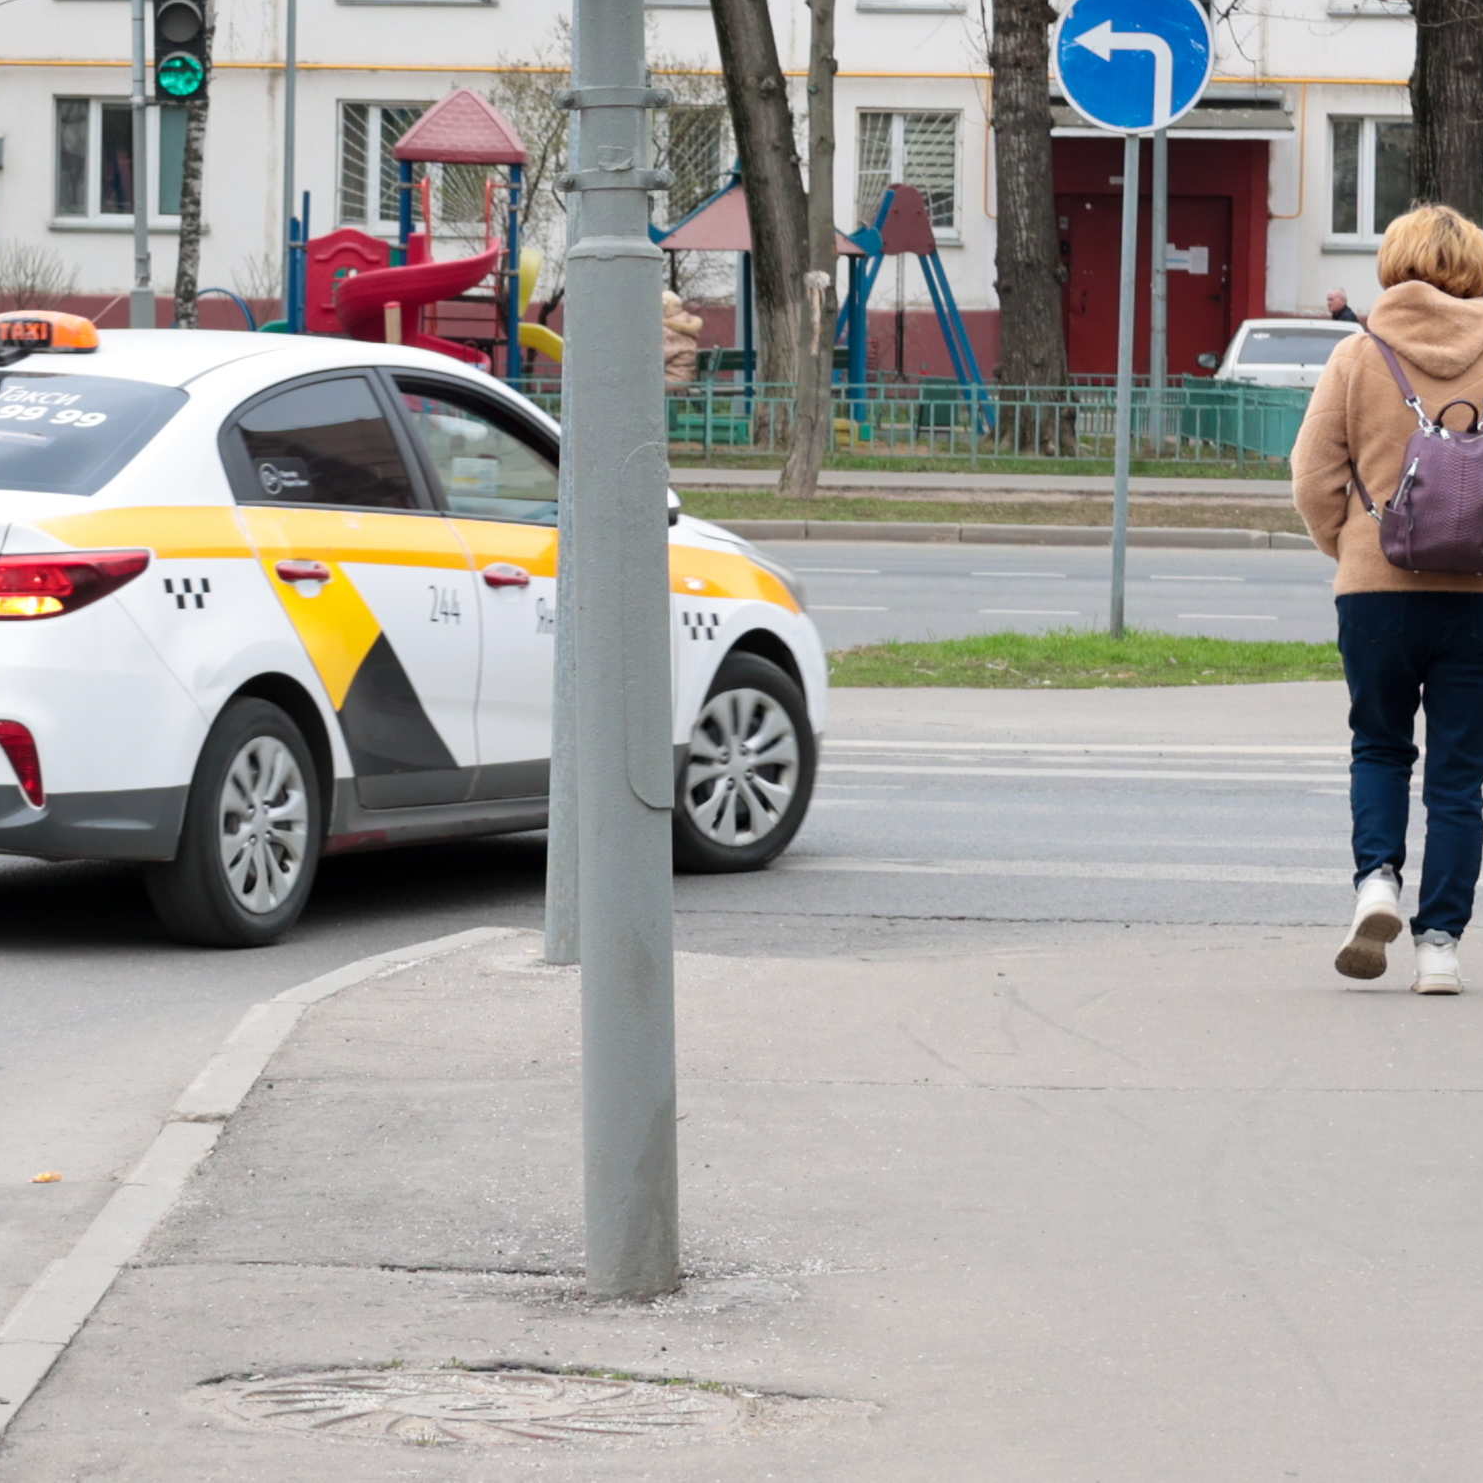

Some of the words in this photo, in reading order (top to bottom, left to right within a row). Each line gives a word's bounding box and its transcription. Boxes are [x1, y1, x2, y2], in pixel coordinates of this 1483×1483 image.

[0, 321, 48, 341] TAXI
[50, 409, 108, 428] 99
[427, 584, 462, 625] 244
